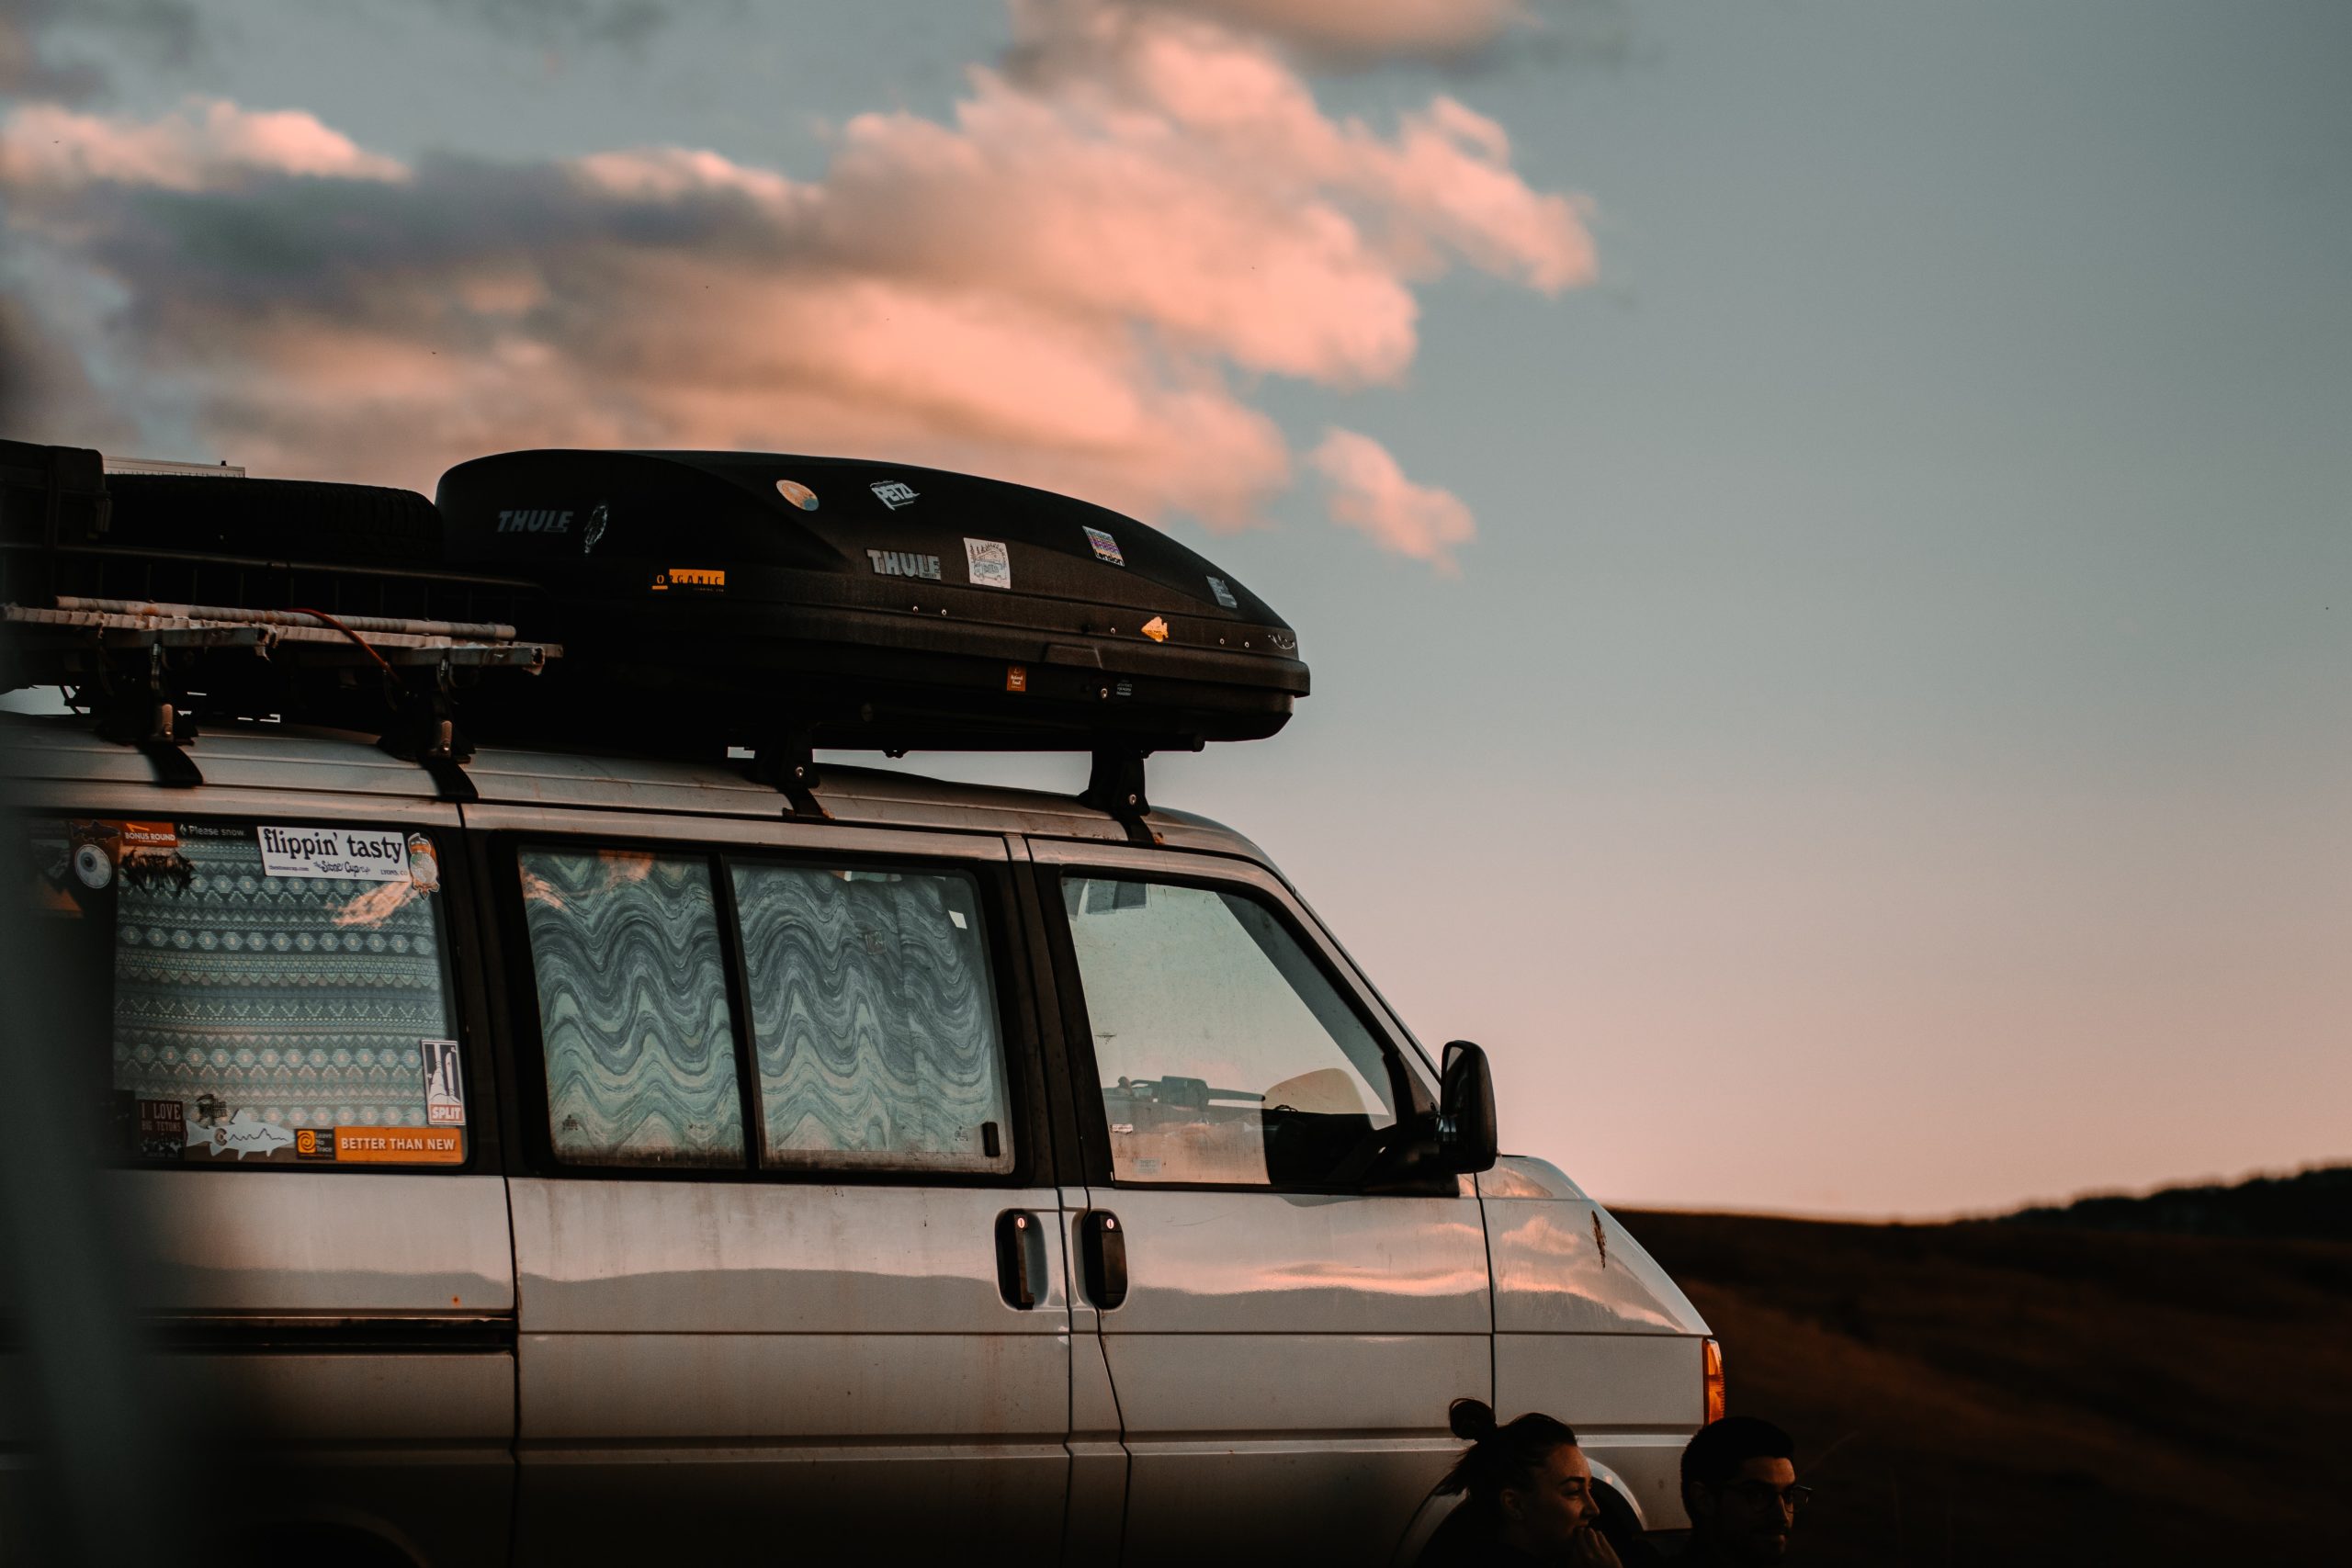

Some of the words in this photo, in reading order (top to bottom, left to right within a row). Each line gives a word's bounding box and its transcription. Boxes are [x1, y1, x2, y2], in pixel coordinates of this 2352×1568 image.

[497, 510, 574, 533] THULE
[866, 548, 941, 580] THULE
[124, 830, 150, 840] BONUS
[150, 832, 175, 841] ROUND
[187, 824, 219, 836] Please
[220, 827, 247, 837] snow.
[264, 828, 339, 860] flippin'
[346, 834, 402, 863] tasty
[141, 1101, 146, 1119] I
[153, 1103, 181, 1120] LOVE
[432, 1107, 461, 1121] SPLIT
[341, 1138, 387, 1150] BETTER
[390, 1138, 424, 1150] THAN
[427, 1139, 455, 1150] NEW
